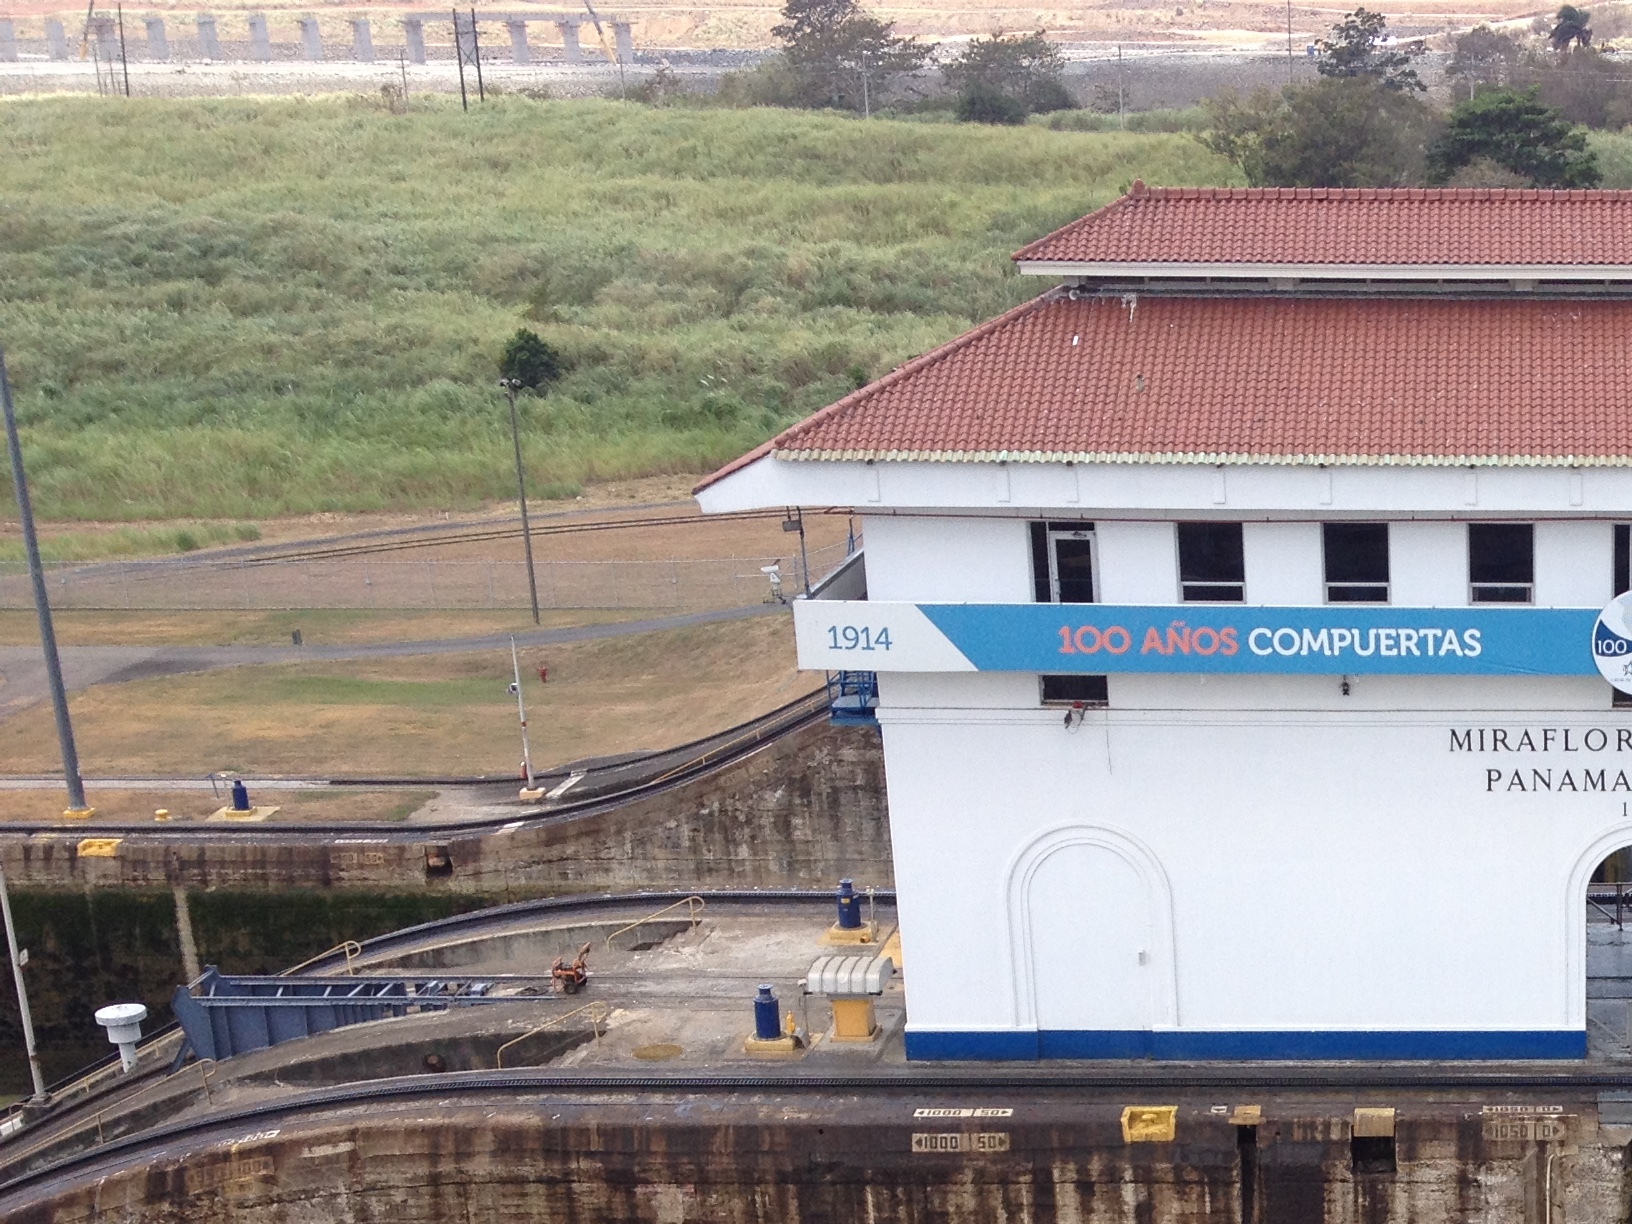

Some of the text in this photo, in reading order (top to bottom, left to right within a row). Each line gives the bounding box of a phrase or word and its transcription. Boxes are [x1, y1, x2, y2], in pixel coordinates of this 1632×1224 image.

[827, 625, 893, 651] 1914
[1058, 621, 1481, 657] 100 AÑOS COMPUERTAS
[1597, 639, 1627, 654] 100
[1486, 768, 1632, 792] PANAMA
[1494, 1124, 1528, 1139] 1050
[1542, 1124, 1551, 1138] 0
[924, 1136, 959, 1150] 1000
[977, 1135, 997, 1149] 50
